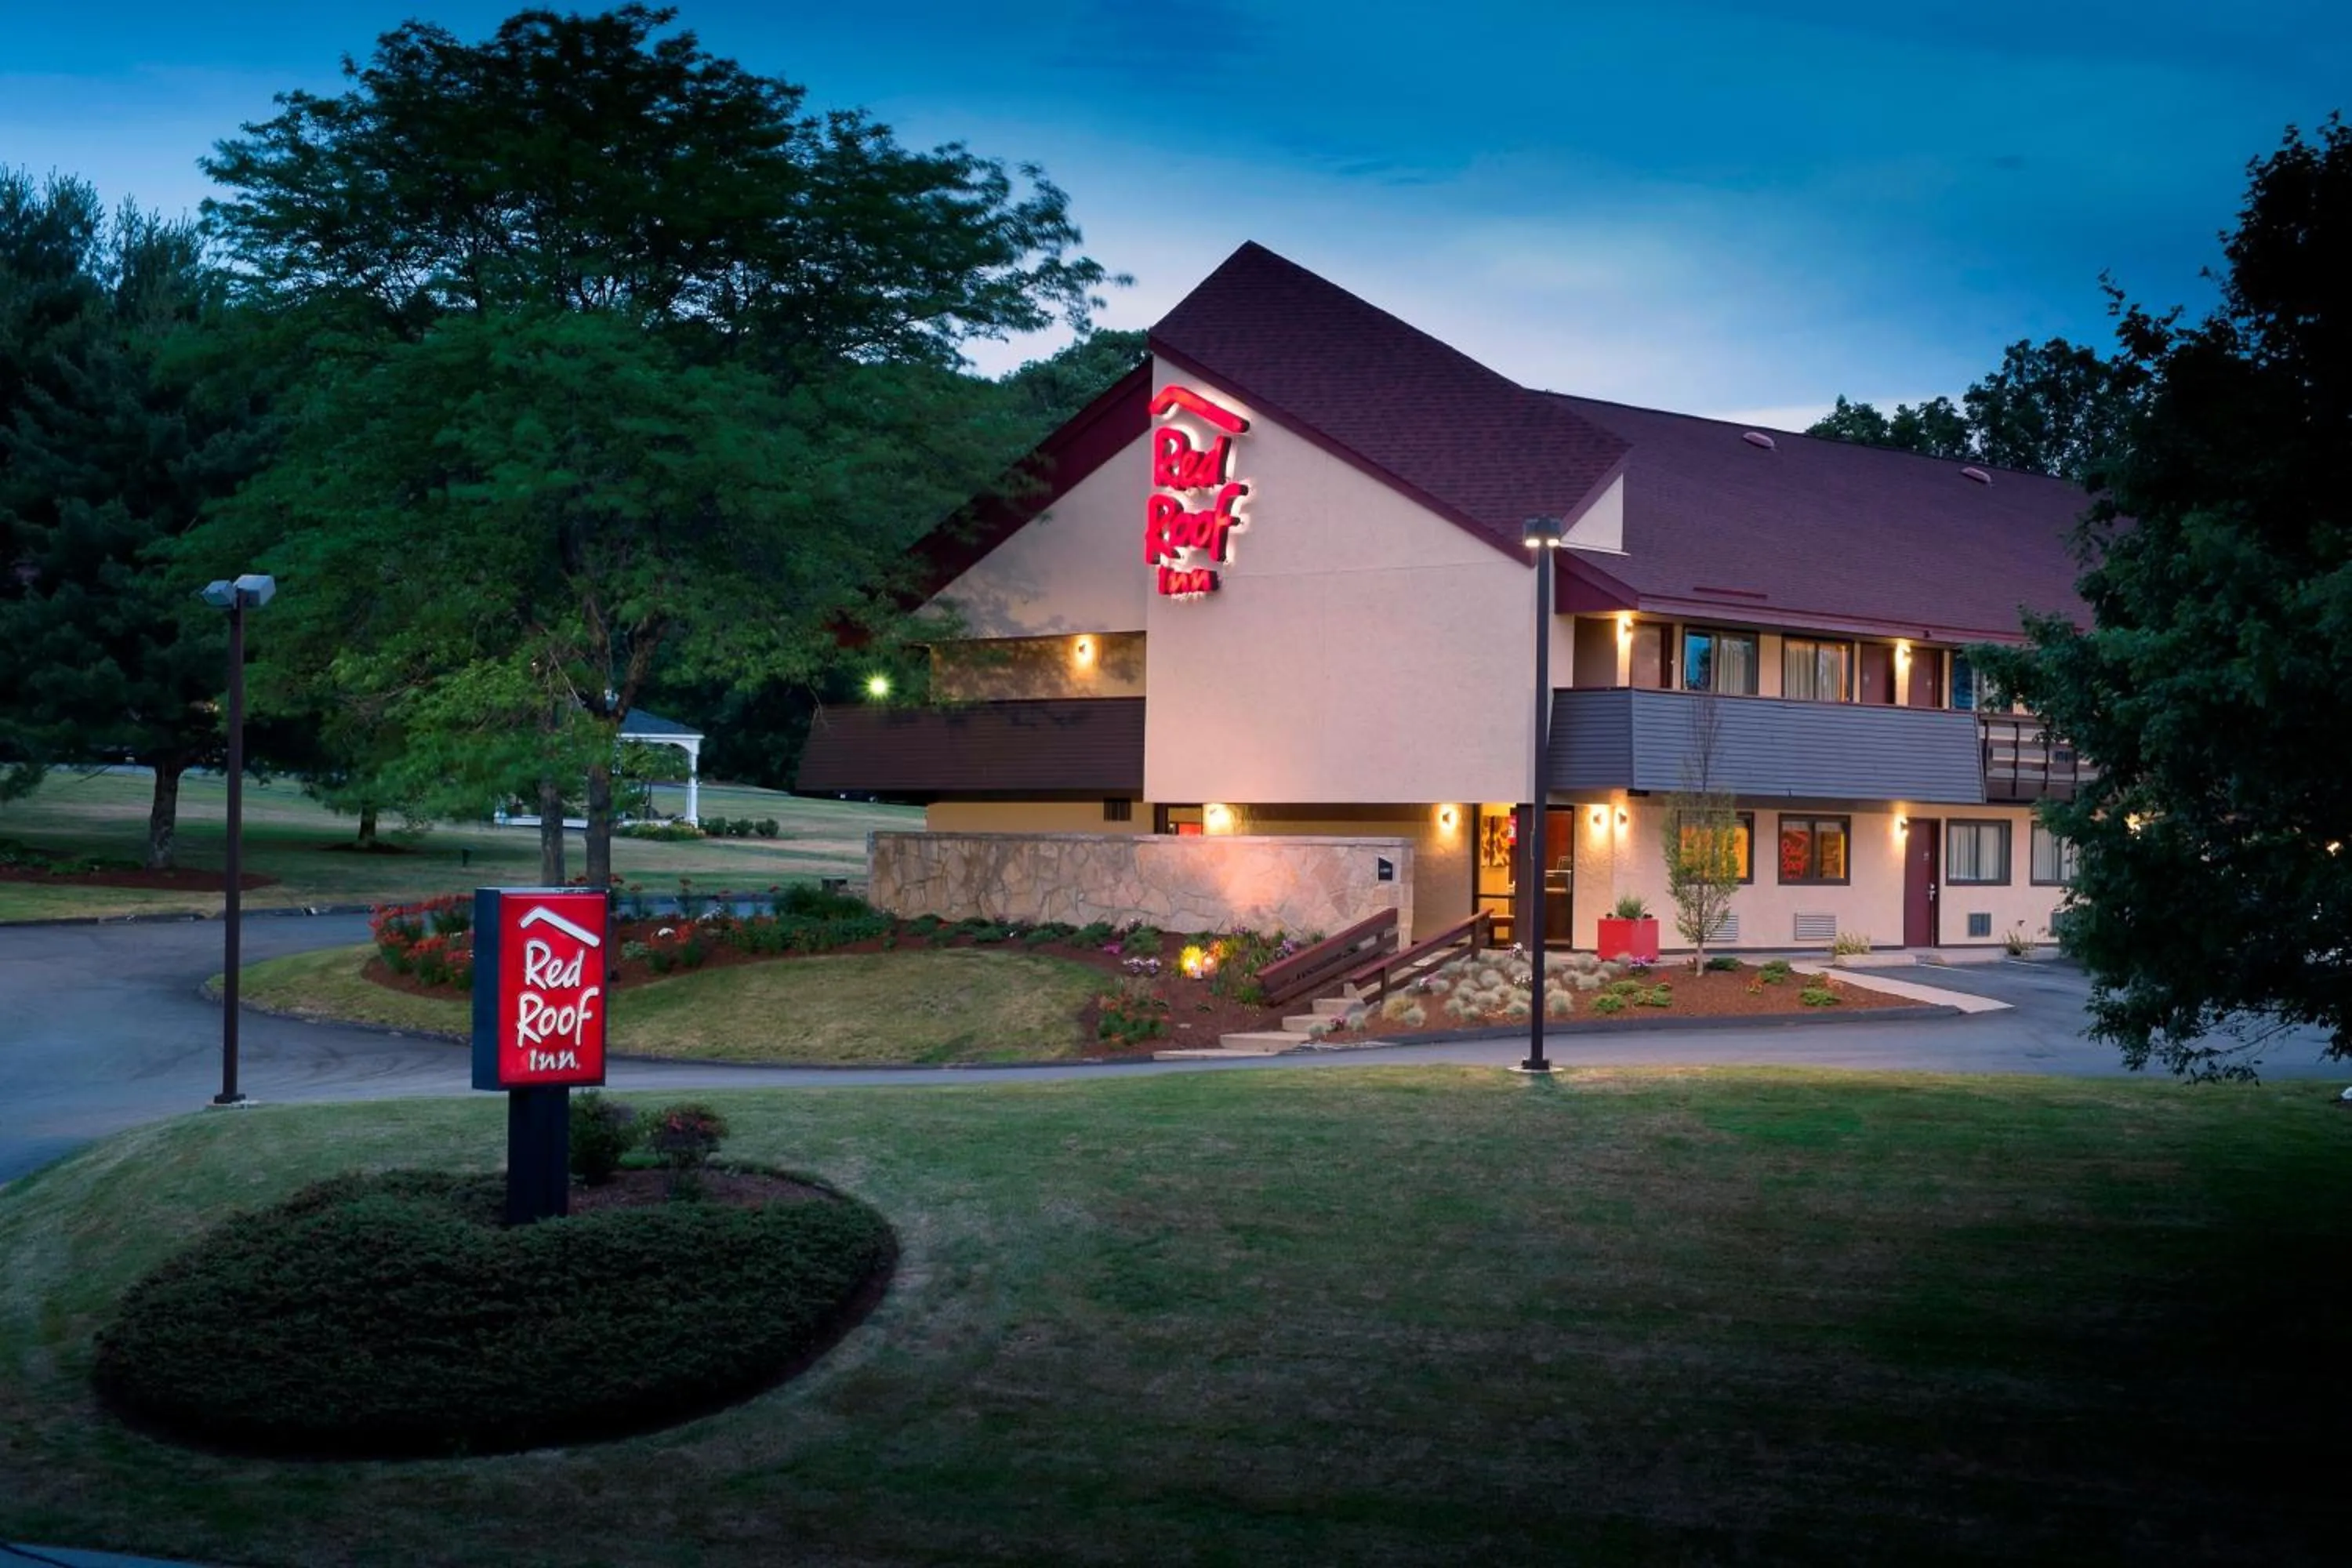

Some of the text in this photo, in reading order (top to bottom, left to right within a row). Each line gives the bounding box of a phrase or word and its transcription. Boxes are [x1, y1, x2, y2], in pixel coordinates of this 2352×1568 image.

[1153, 426, 1232, 491] Red
[1145, 482, 1249, 564] Roof
[1158, 567, 1218, 596] Inn
[524, 939, 585, 990] Red
[517, 987, 600, 1047] Roof
